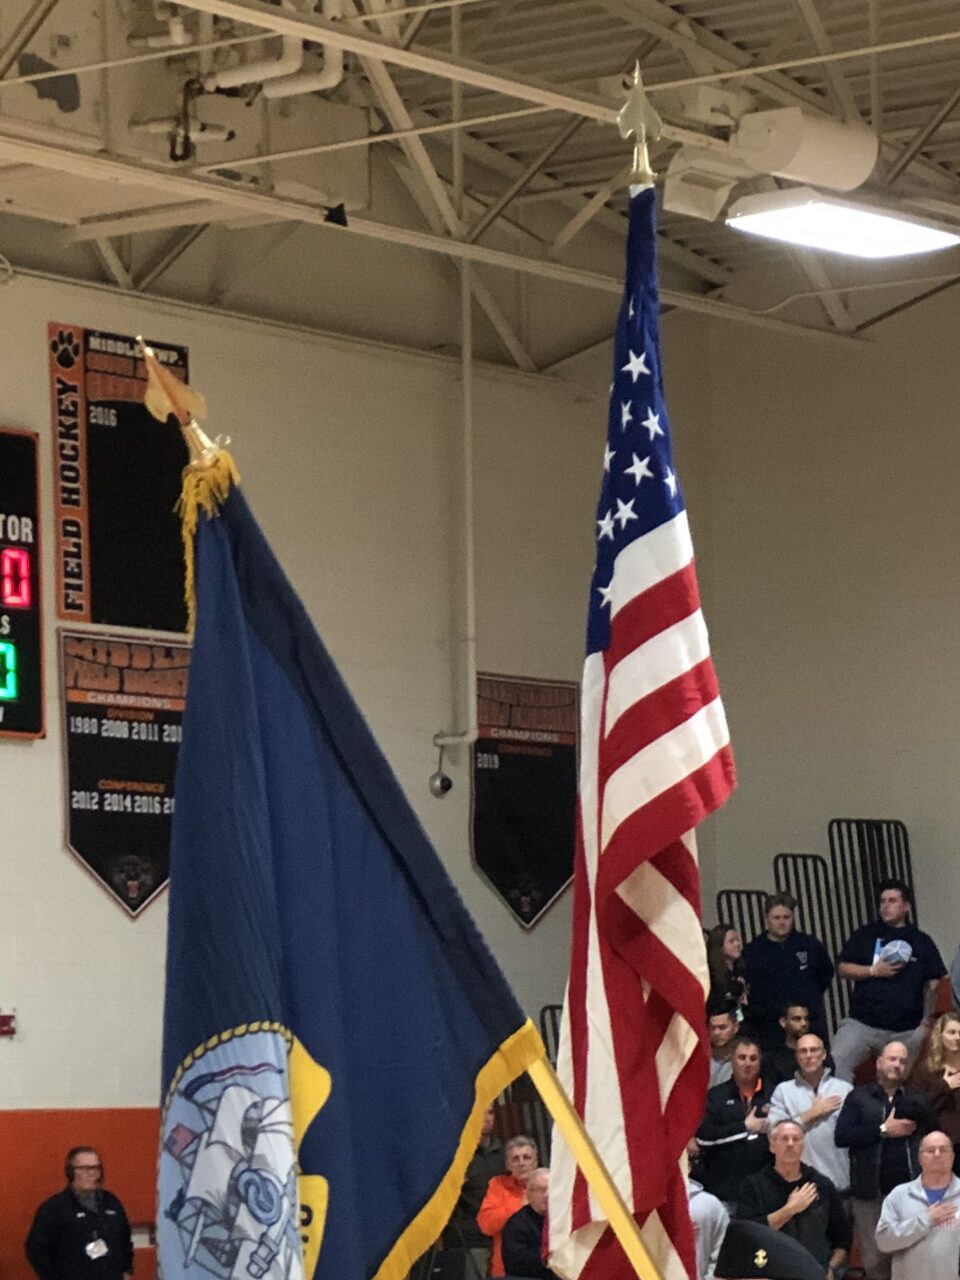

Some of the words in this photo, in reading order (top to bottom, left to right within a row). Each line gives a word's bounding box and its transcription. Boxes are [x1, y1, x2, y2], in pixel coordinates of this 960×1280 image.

[89, 405, 118, 428] 2016
[57, 376, 81, 508] HOCKEY
[61, 518, 85, 613] FIELD
[86, 692, 171, 709] CHAMPIONS
[131, 722, 159, 742] 2011
[491, 728, 559, 744] CHAMPIONS
[104, 793, 132, 812] 2014
